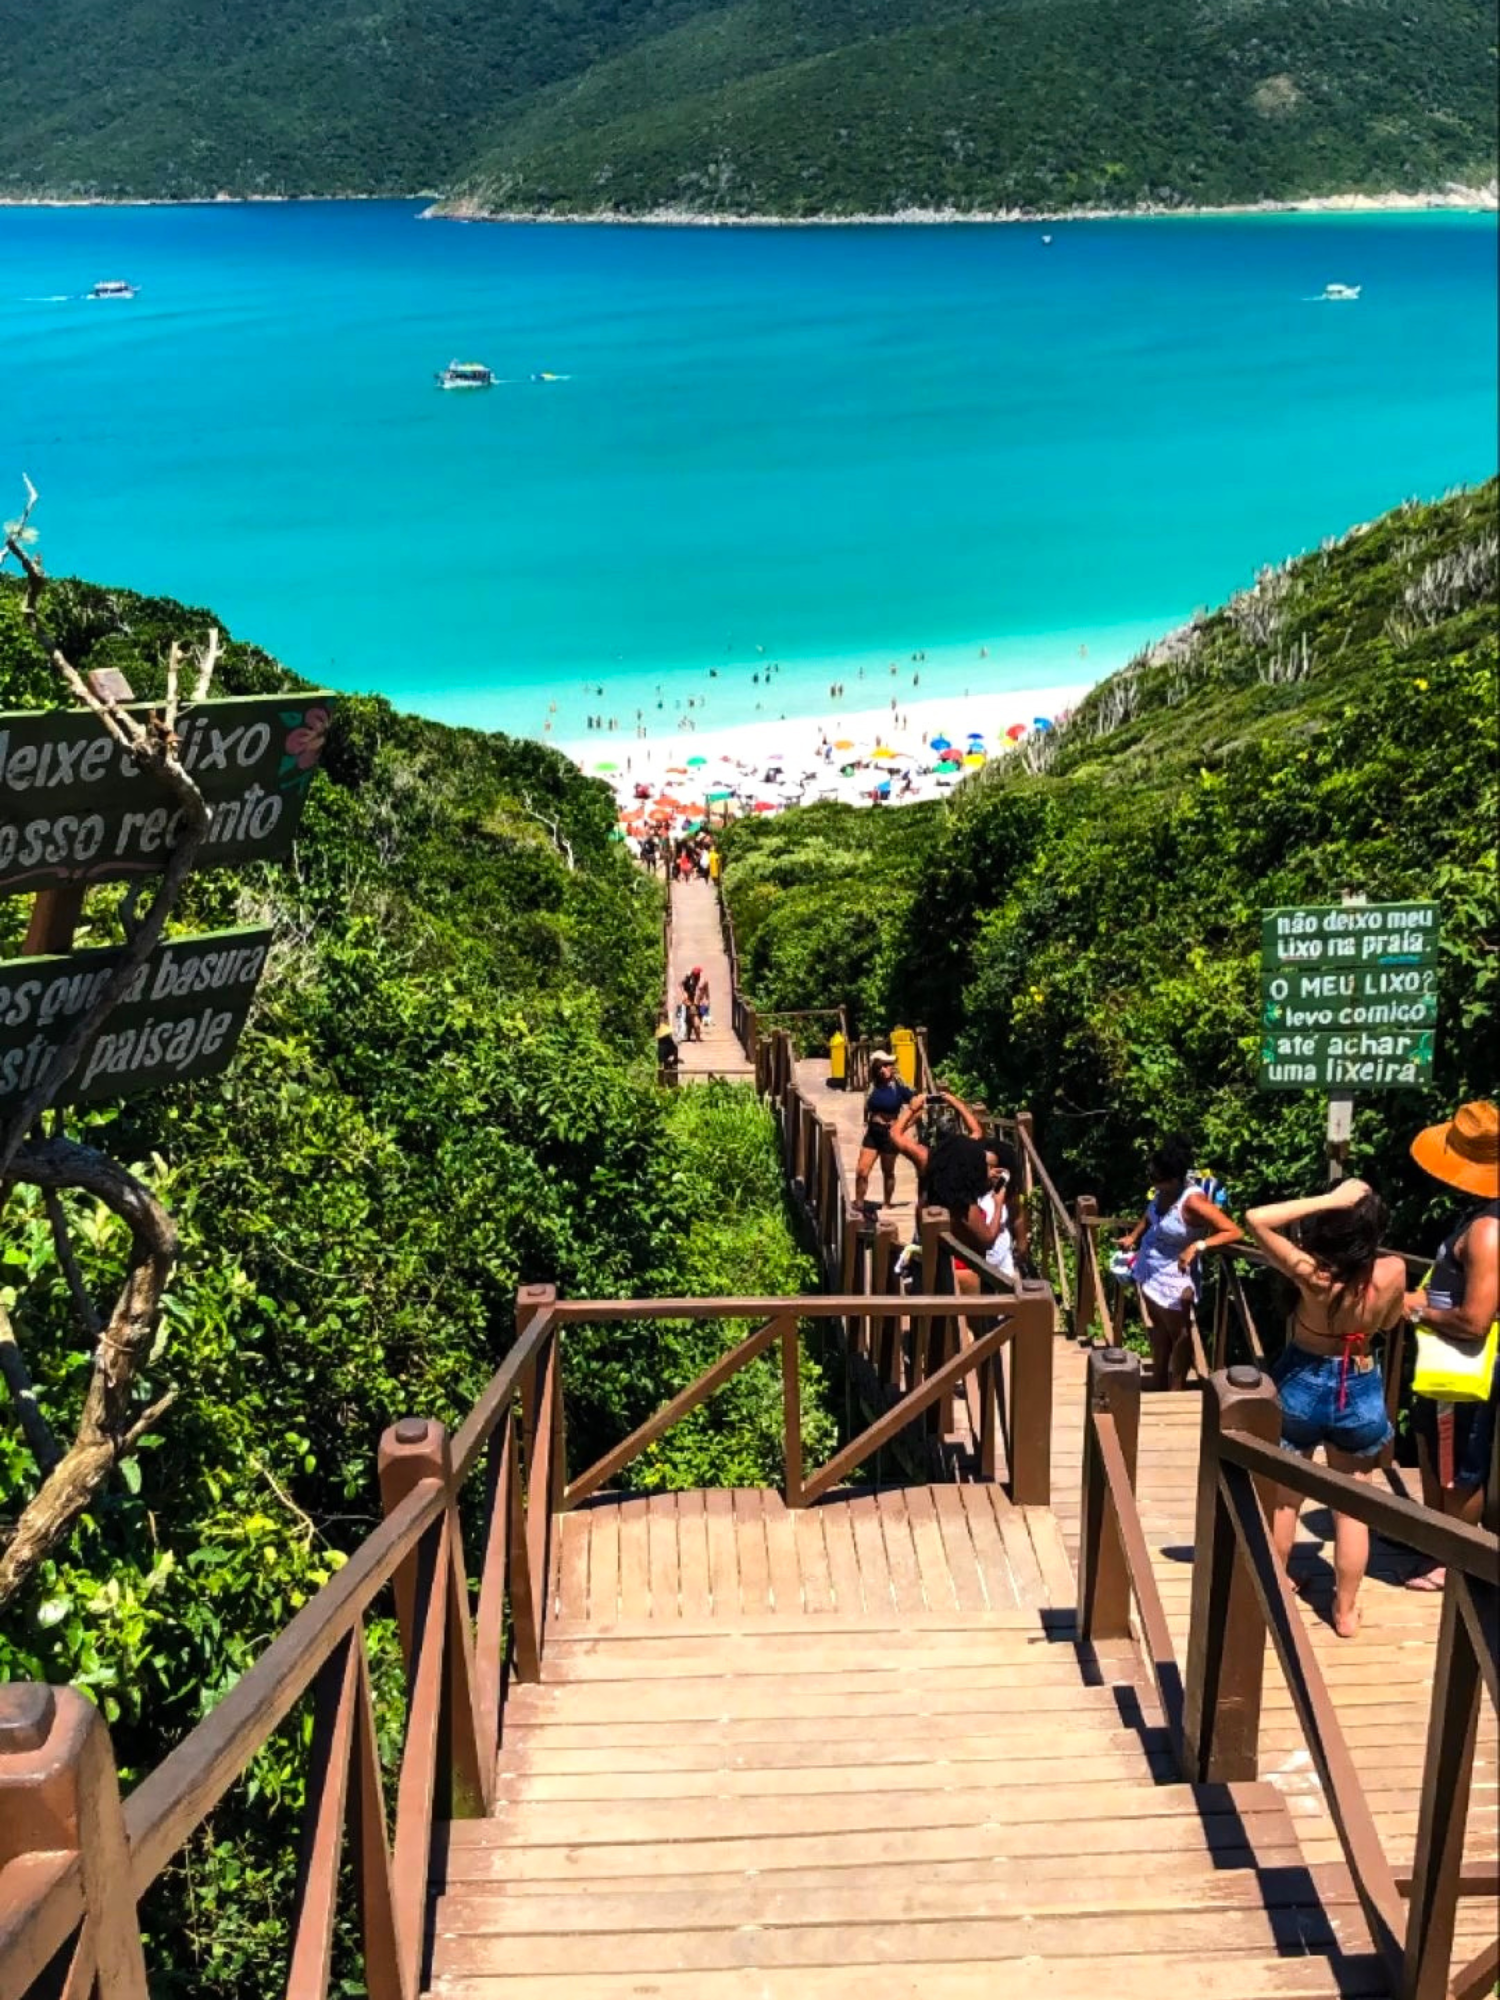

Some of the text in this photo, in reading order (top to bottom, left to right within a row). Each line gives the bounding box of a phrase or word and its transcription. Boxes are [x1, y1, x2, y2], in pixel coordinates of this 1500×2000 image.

[115, 782, 283, 856] recnto
[1277, 909, 1433, 935] não deixo meu
[1327, 935, 1356, 956] na
[115, 962, 151, 1005] a
[150, 945, 266, 1001] basura
[1269, 970, 1434, 1001] O MEU LIXO?
[1285, 1006, 1333, 1027] levo
[80, 1007, 233, 1092] paisaje
[1277, 1032, 1411, 1056] até achar
[1268, 1063, 1317, 1081] uma
